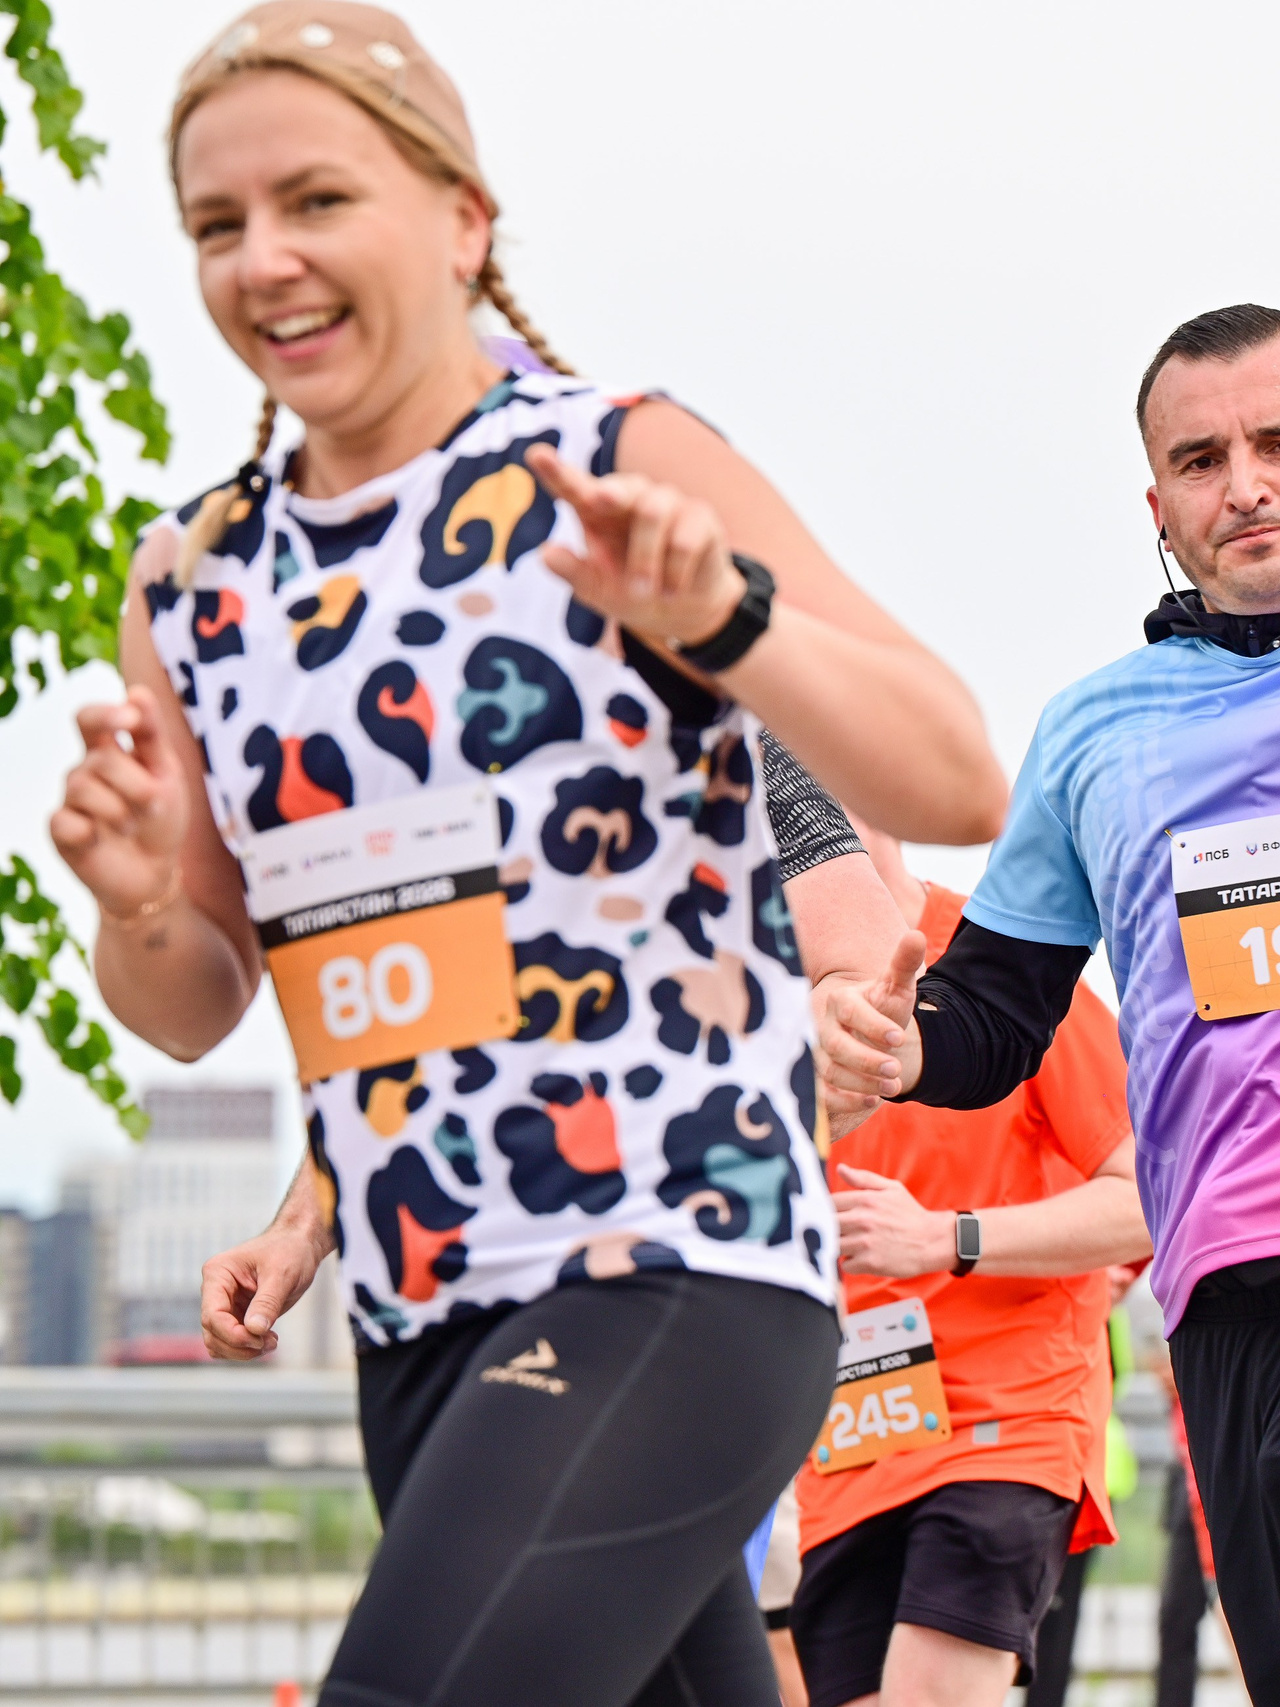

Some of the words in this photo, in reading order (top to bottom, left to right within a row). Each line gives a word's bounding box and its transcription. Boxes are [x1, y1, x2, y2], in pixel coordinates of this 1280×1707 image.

[1205, 848, 1230, 862] ПСБ
[318, 941, 434, 1040] 80
[828, 1384, 920, 1450] 245
